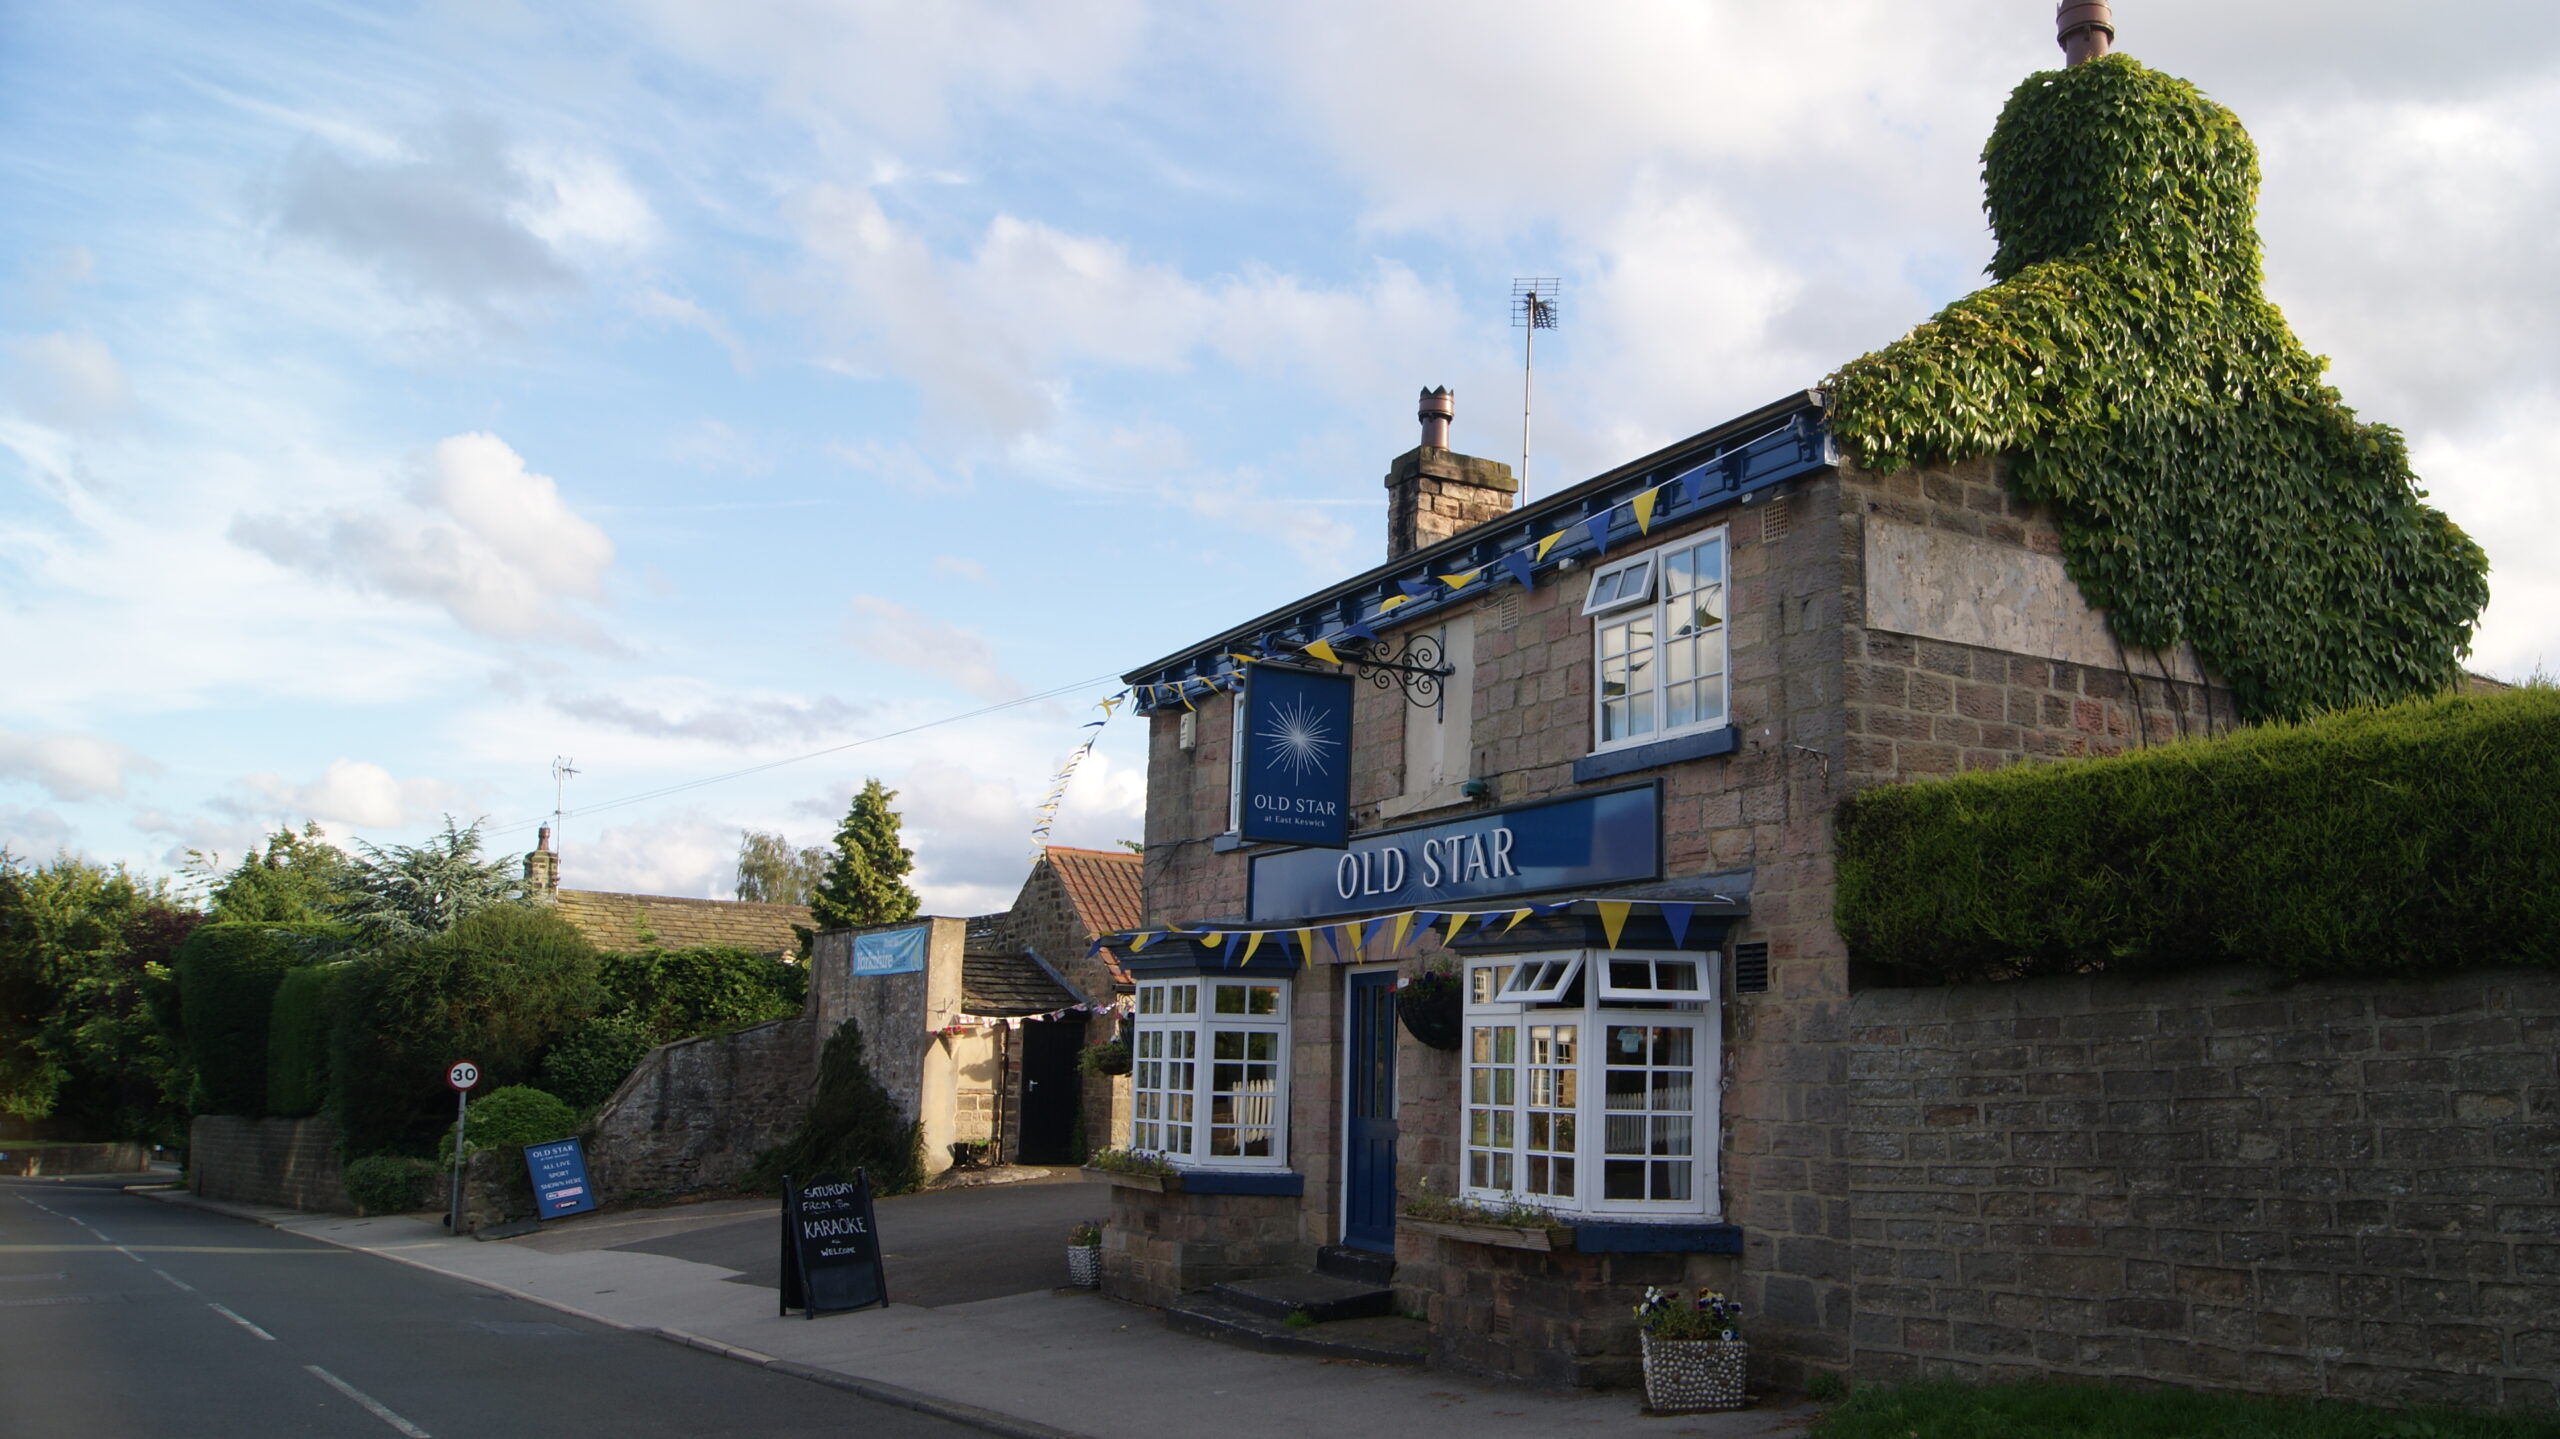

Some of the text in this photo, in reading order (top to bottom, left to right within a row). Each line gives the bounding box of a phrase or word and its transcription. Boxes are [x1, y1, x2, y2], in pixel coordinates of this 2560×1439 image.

[1254, 794, 1336, 816] OLD STAR
[1275, 815, 1292, 824] East
[1294, 817, 1325, 827] Keswick
[1337, 827, 1515, 899] OLD STAR
[453, 1068, 476, 1081] 30
[532, 1149, 551, 1158] OLD
[552, 1145, 574, 1154] STAR
[556, 1160, 571, 1168] LIVE
[803, 1182, 854, 1198] SATURDAY
[803, 1217, 867, 1239] KARAOKE
[820, 1246, 856, 1257] WELCOME
